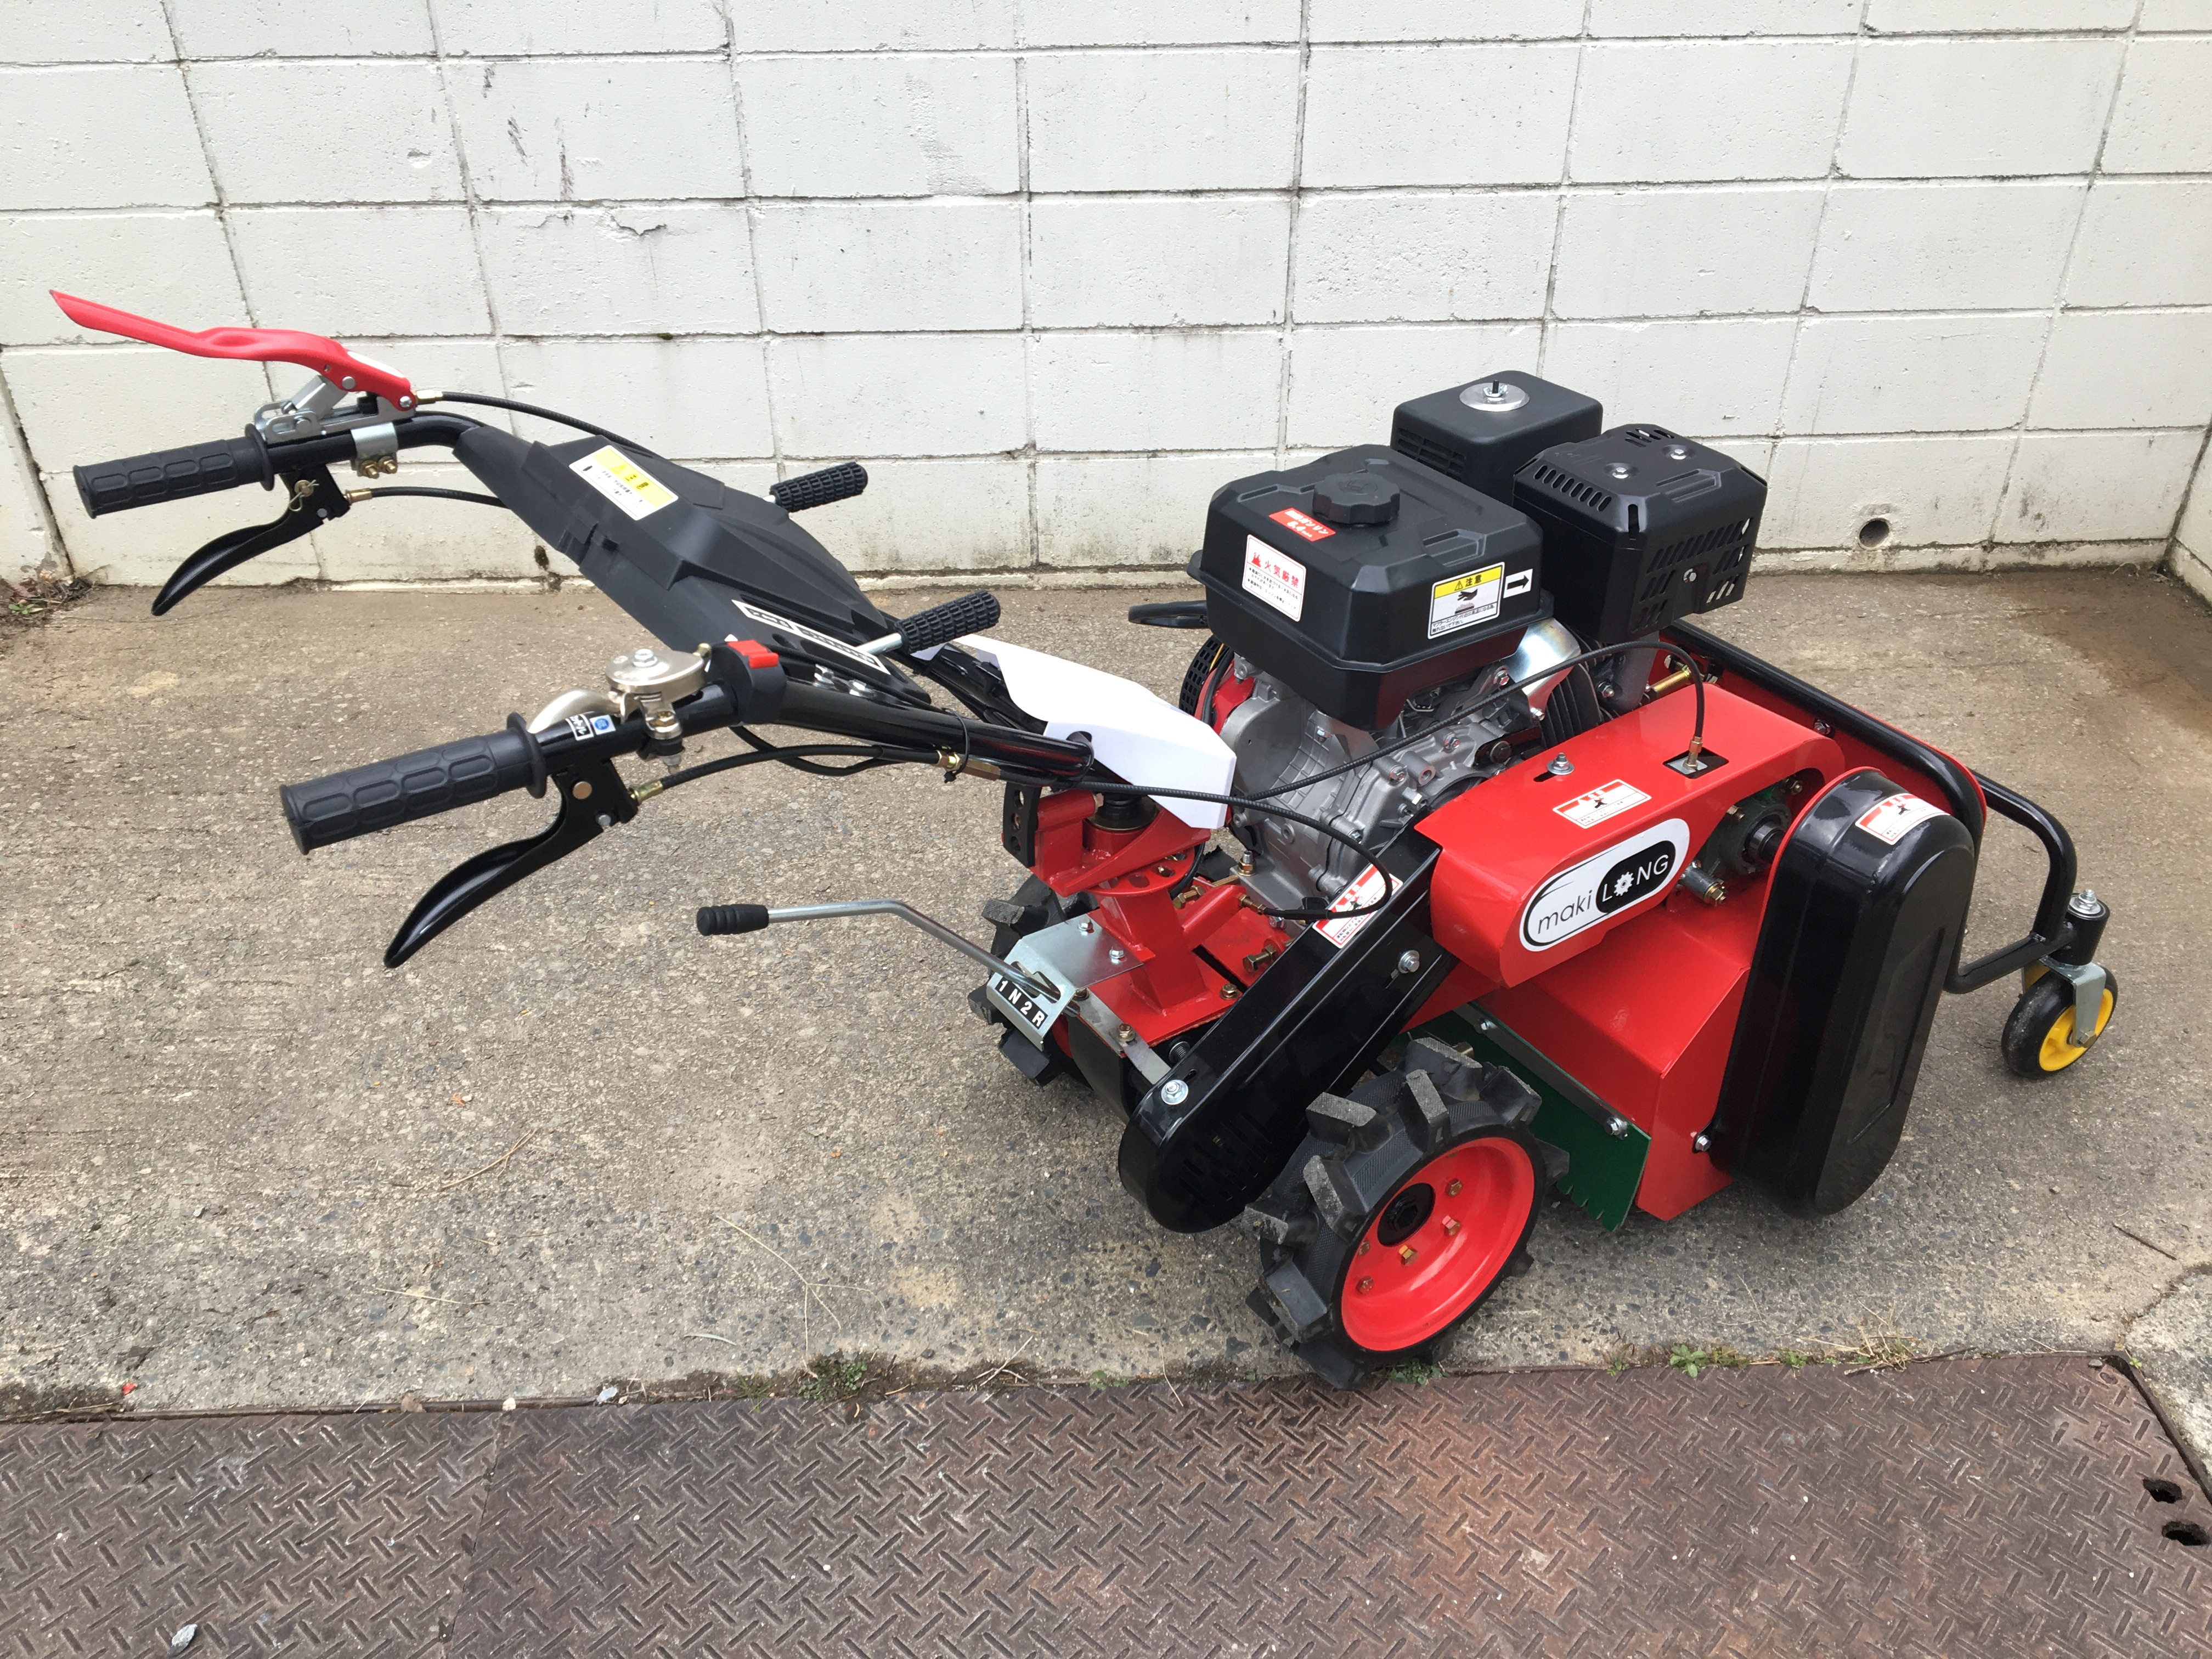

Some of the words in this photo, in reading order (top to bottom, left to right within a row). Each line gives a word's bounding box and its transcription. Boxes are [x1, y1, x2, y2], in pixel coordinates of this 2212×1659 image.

[1264, 560, 1299, 589] 火気厳禁
[1465, 574, 1482, 587] 注意
[1538, 889, 1593, 935] maki
[999, 980, 1008, 992] 1
[1008, 989, 1022, 1005] N
[1020, 1001, 1032, 1015] 2
[1031, 1010, 1045, 1027] R
